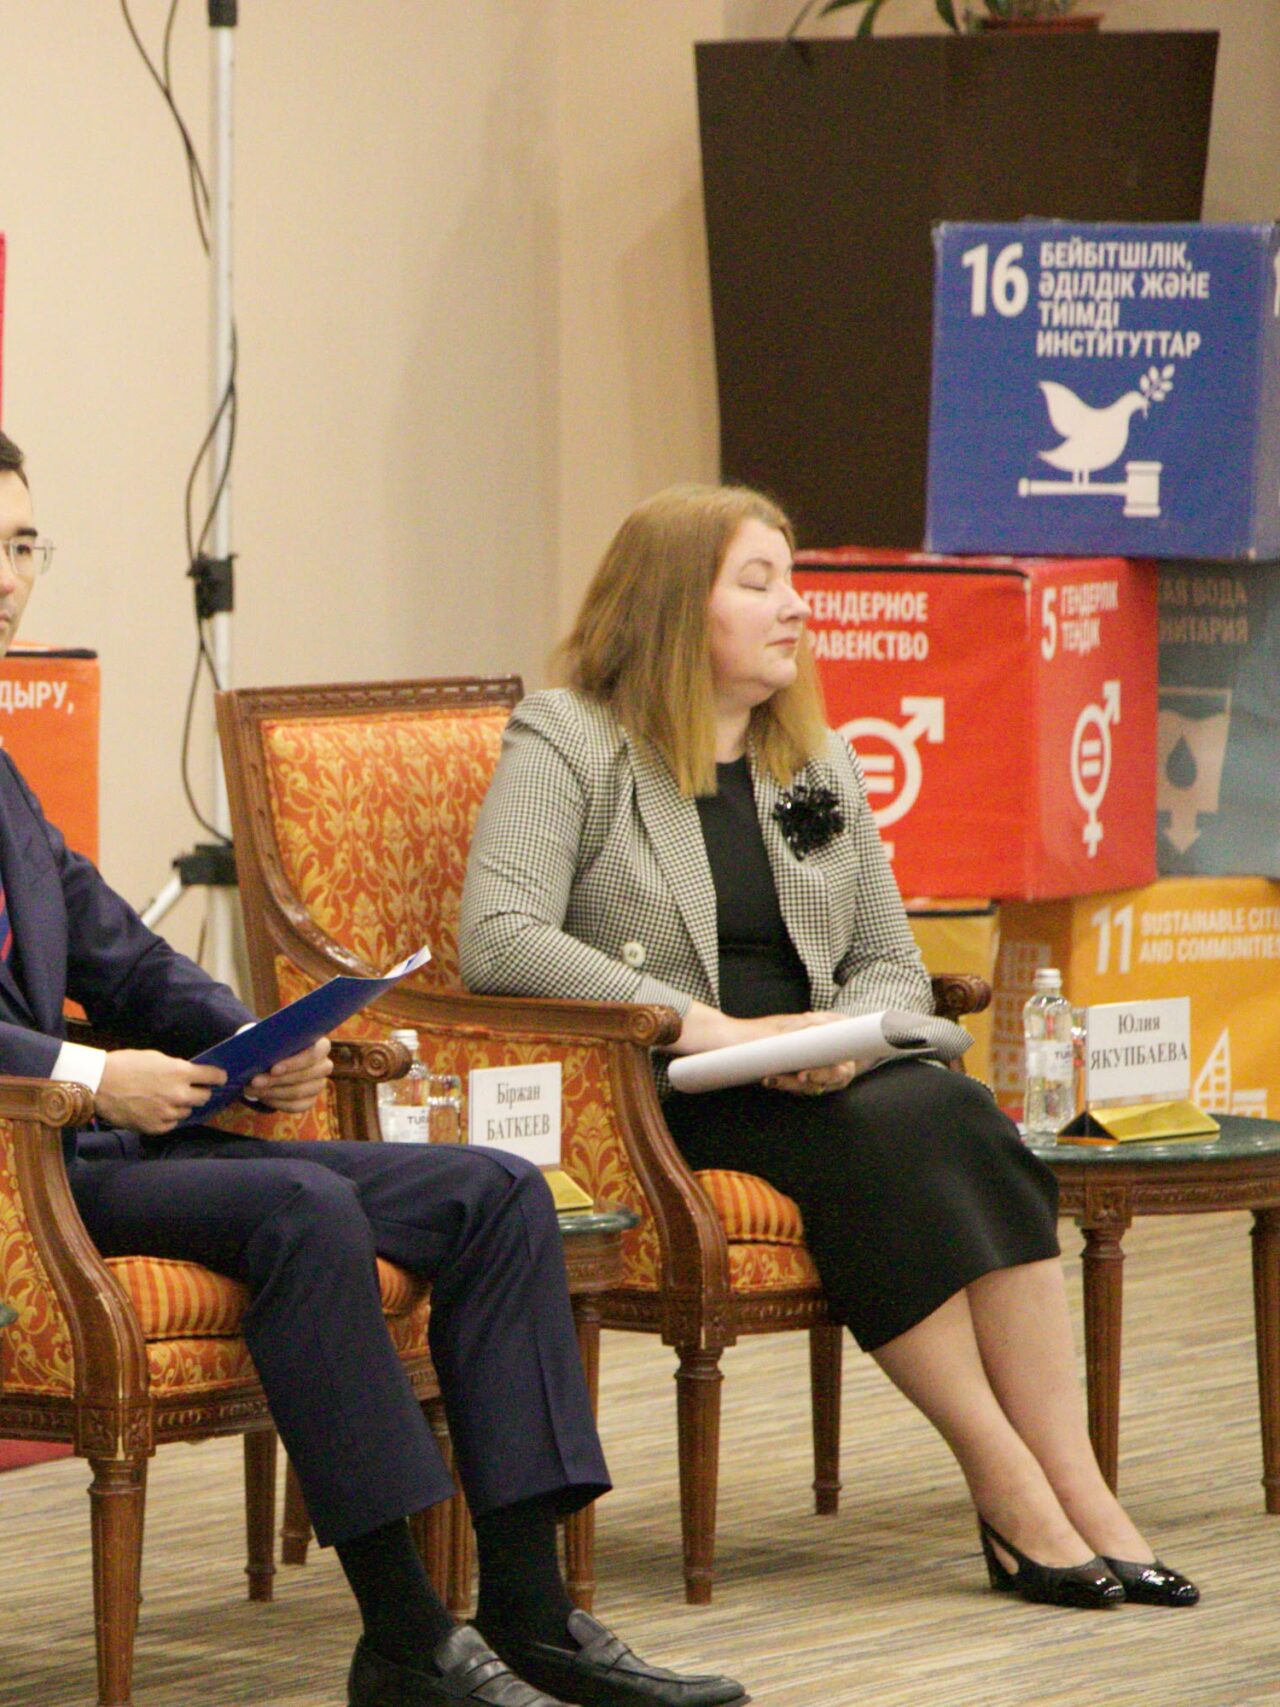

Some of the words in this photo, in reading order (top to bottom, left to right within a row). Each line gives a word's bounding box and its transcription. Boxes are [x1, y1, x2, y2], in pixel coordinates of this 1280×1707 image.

[1039, 237, 1192, 272] БЕЙБІТШІЛІК,
[962, 243, 1029, 318] 16
[1038, 271, 1136, 301] ӘДІЛДІК
[1140, 272, 1210, 298] ЖӘНЕ
[1036, 330, 1201, 358] ИНСТИТУТТАР
[803, 590, 929, 626] ГЕНДЕРНОЕ
[1041, 587, 1057, 661] 5
[1141, 908, 1245, 936] SUSTAINABLE
[1091, 904, 1134, 975] 11
[1139, 938, 1174, 964] AND
[1118, 1013, 1161, 1036] Юлия
[1090, 1043, 1188, 1071] ЯКУПБАЕВА
[496, 1082, 541, 1110] Біржан
[486, 1113, 550, 1141] БАТКЕЕВ
